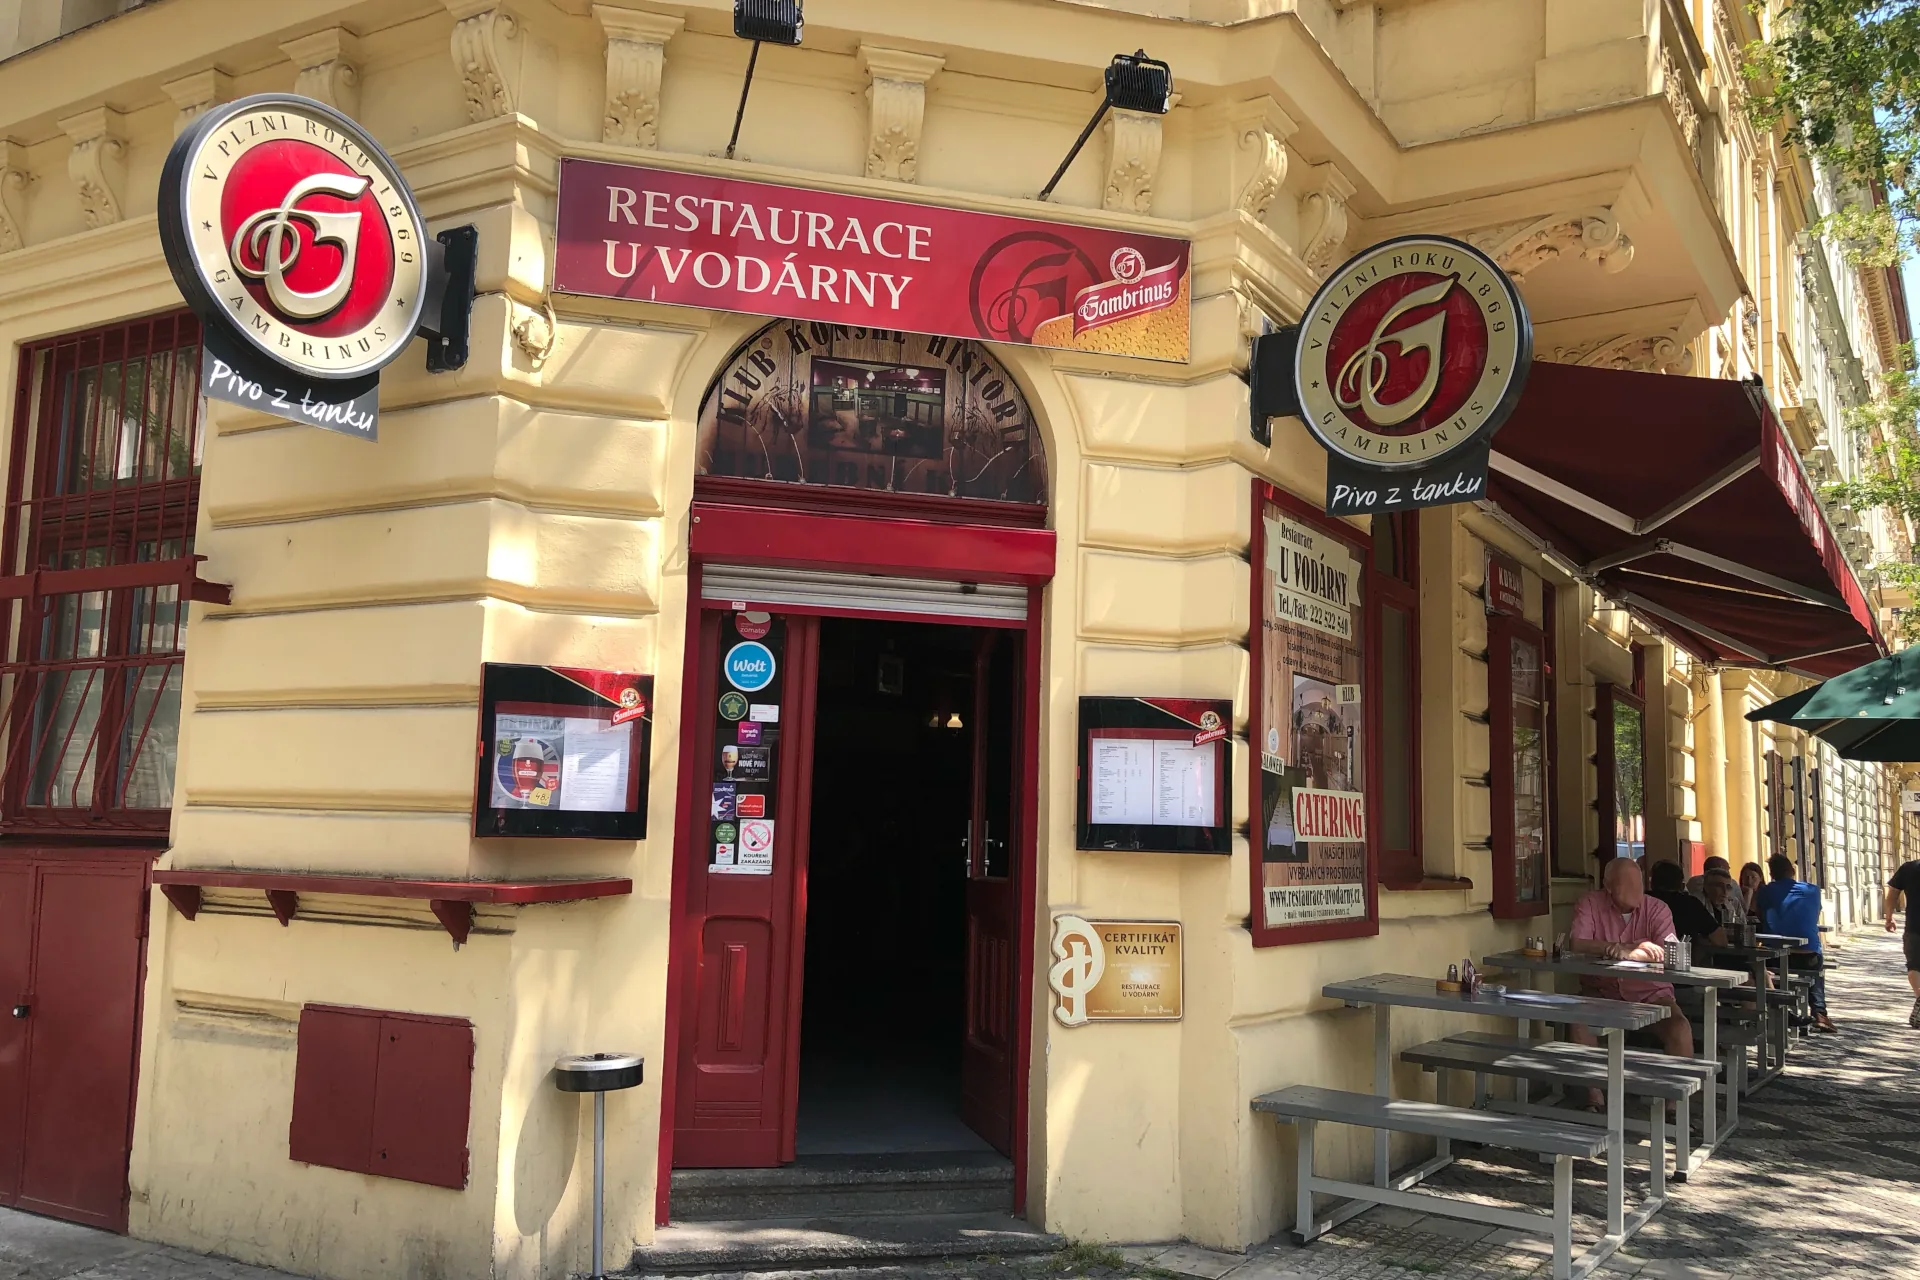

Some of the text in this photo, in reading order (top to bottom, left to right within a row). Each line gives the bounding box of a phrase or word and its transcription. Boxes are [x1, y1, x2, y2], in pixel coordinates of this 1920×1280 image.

[203, 115, 413, 264] V PLZNI ROKU 1869
[606, 186, 932, 262] RESTAURACE
[603, 239, 913, 310] U VODÁRNY
[214, 268, 388, 359] GAMBRINUS
[1078, 281, 1172, 321] Gambrinus
[1310, 252, 1506, 350] V PLZNI ROKU 1869
[208, 359, 374, 432] Pivo z tanku
[1322, 401, 1484, 455] GAMBRINUS
[1331, 472, 1482, 509] Pivo z tanku
[1281, 522, 1313, 551] Restaurace
[1280, 545, 1348, 606] U VODÁRNY
[1310, 604, 1322, 625] 222
[733, 659, 767, 672] Wolt
[1296, 791, 1363, 840] CATERING
[1104, 932, 1176, 943] CERTIFIKÁT
[1115, 946, 1166, 955] KVALITY
